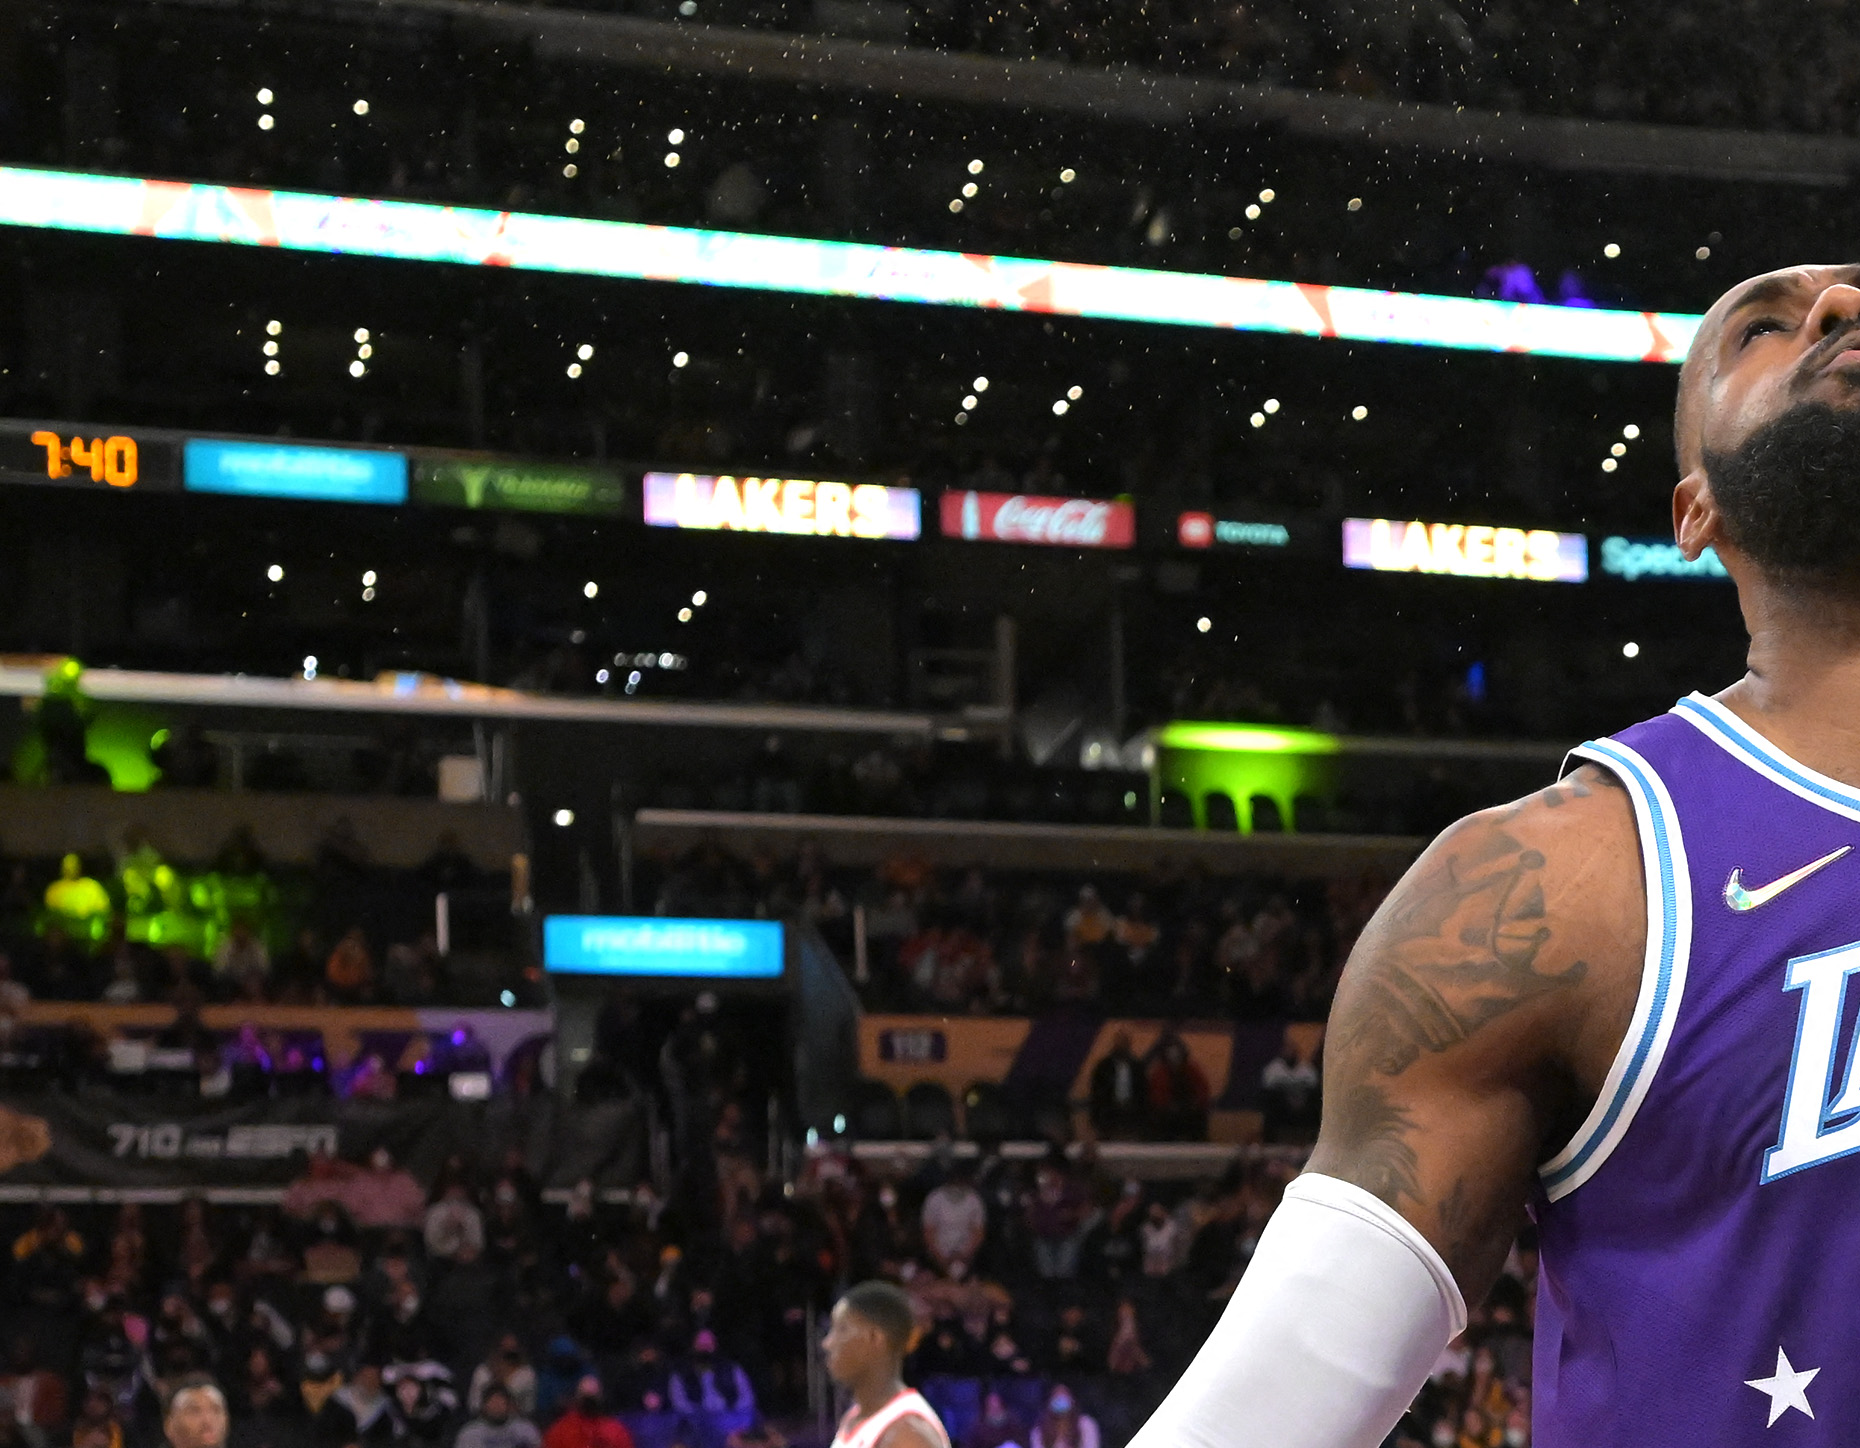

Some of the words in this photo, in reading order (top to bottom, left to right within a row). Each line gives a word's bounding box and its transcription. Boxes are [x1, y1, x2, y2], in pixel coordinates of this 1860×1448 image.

[30, 430, 138, 488] 7:40
[676, 472, 889, 539] LAKERS
[1370, 518, 1560, 581] LAKERS
